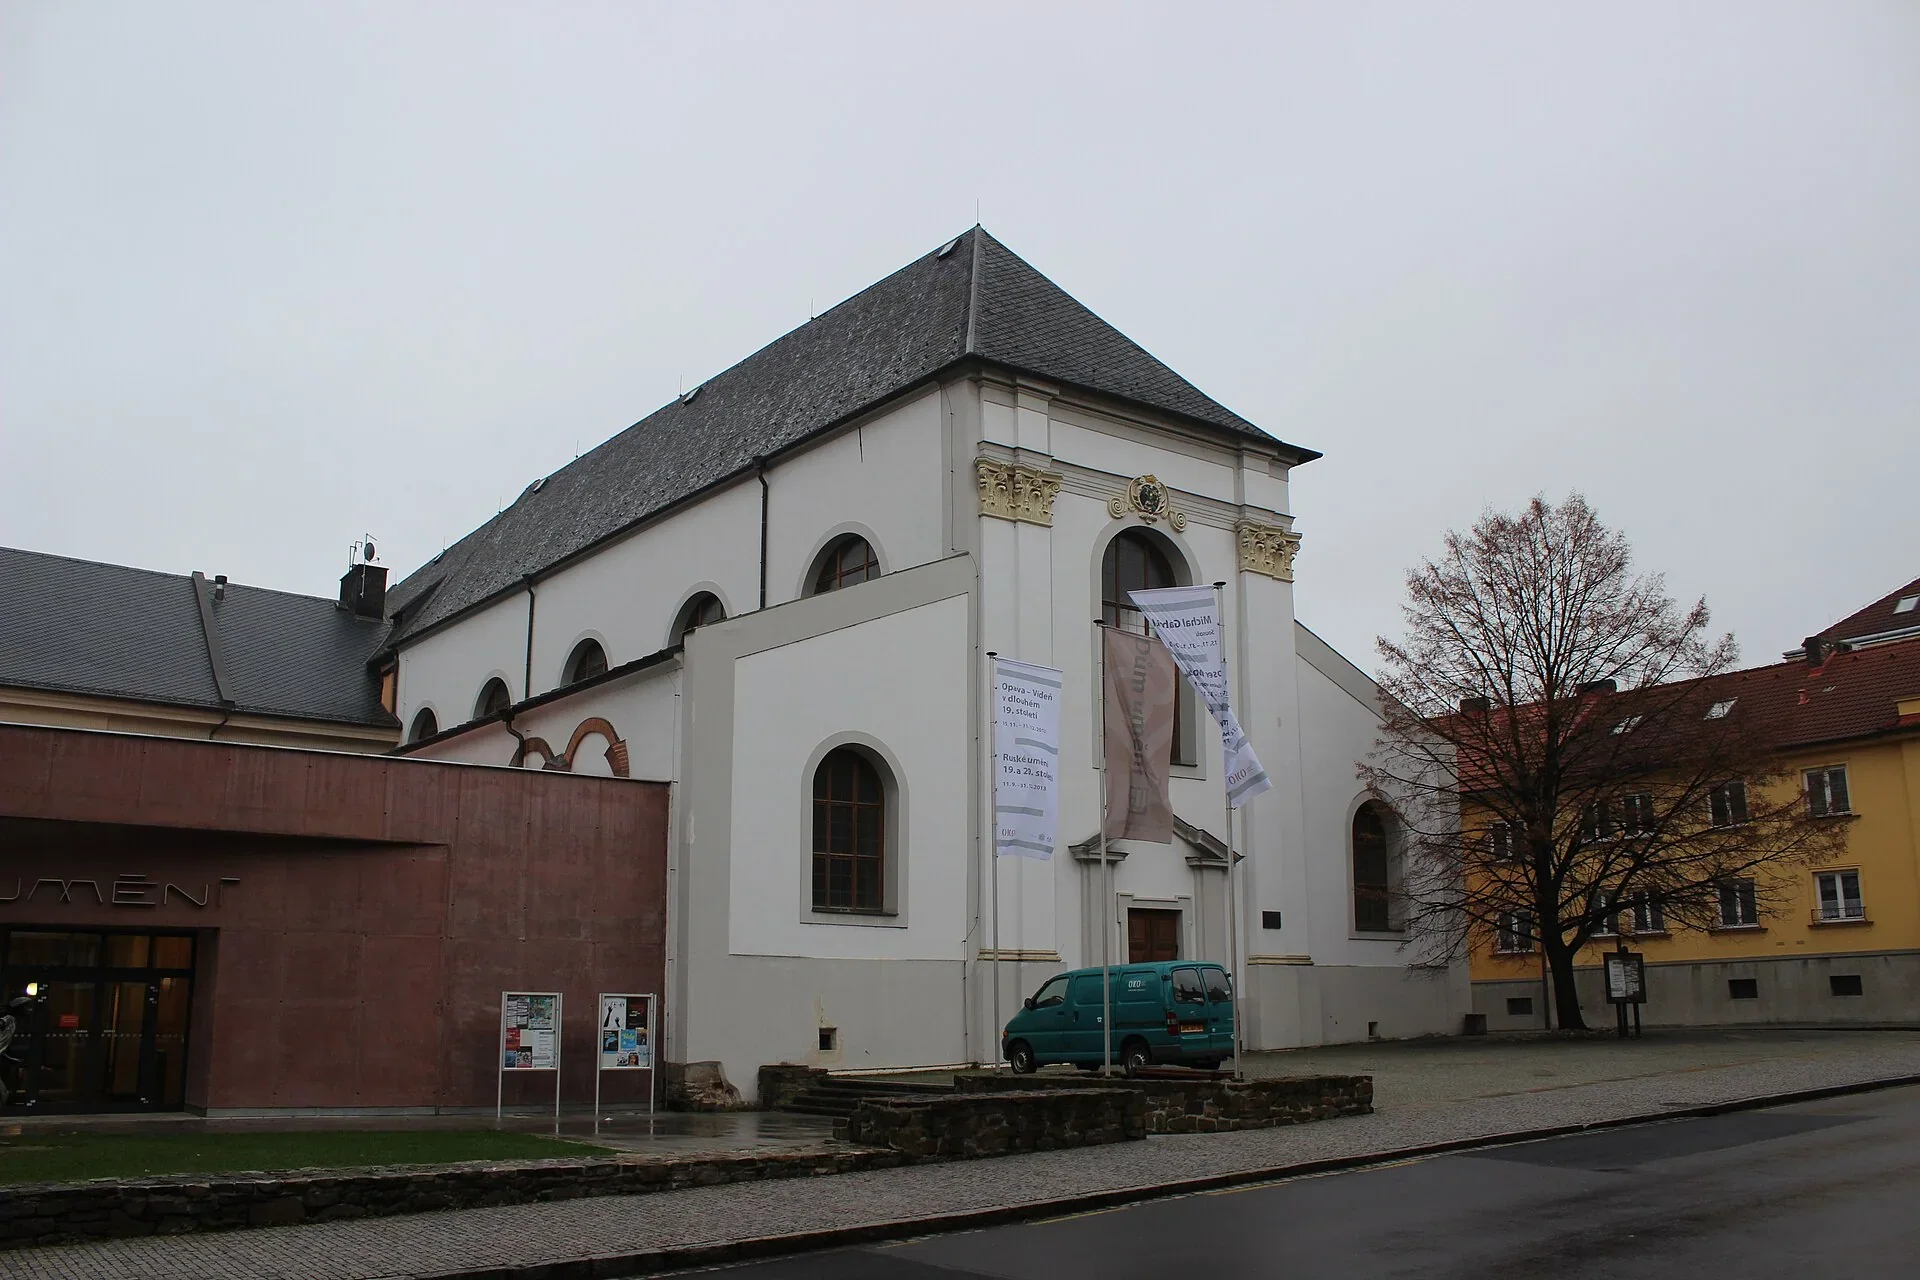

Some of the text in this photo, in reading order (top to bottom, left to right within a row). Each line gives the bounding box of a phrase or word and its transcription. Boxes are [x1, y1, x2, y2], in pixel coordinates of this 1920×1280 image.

[1002, 682, 1025, 694] Opava
[1007, 694, 1040, 709] dlouhém
[1003, 706, 1014, 714] 19.
[1003, 753, 1027, 763] Ruské
[1003, 765, 1016, 774] 19.
